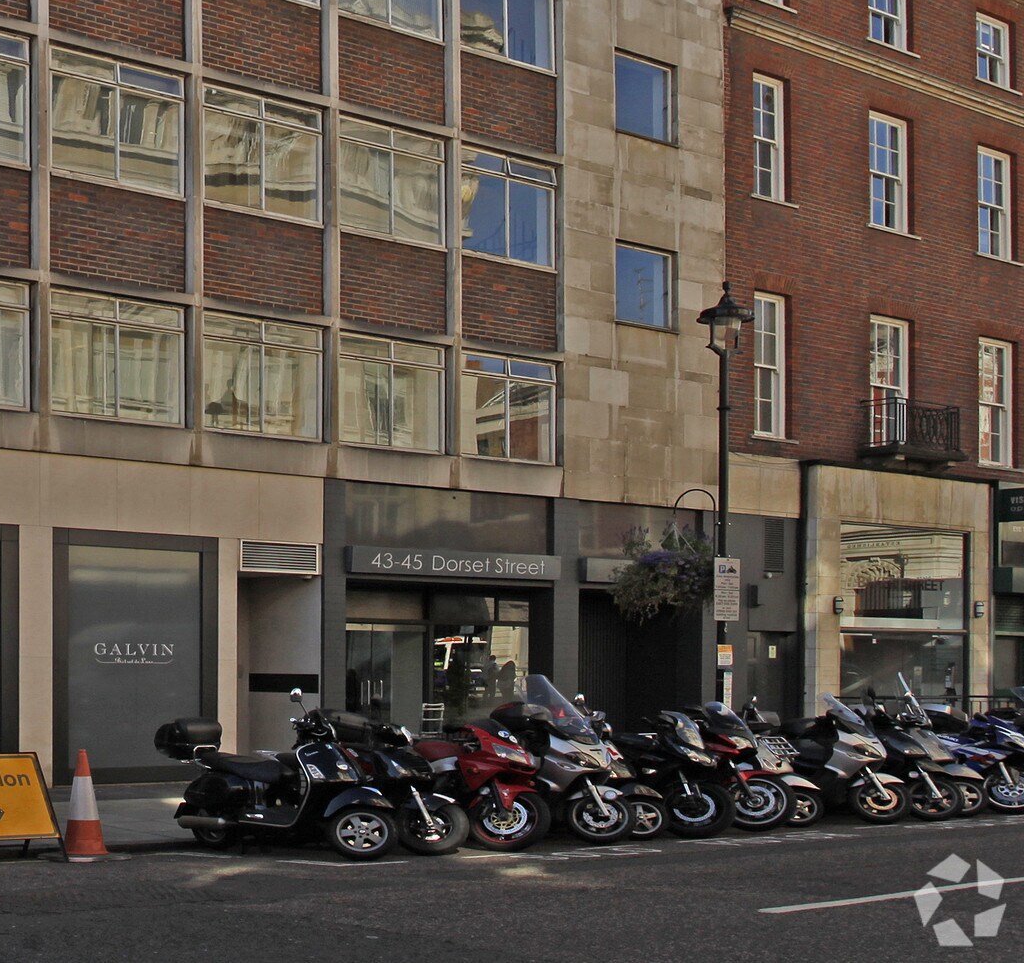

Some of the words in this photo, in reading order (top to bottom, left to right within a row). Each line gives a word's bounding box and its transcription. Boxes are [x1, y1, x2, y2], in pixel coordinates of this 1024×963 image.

[371, 552, 423, 570] 43-45
[432, 555, 490, 572] Dorset
[494, 557, 545, 575] Street
[94, 642, 174, 656] GALVIN
